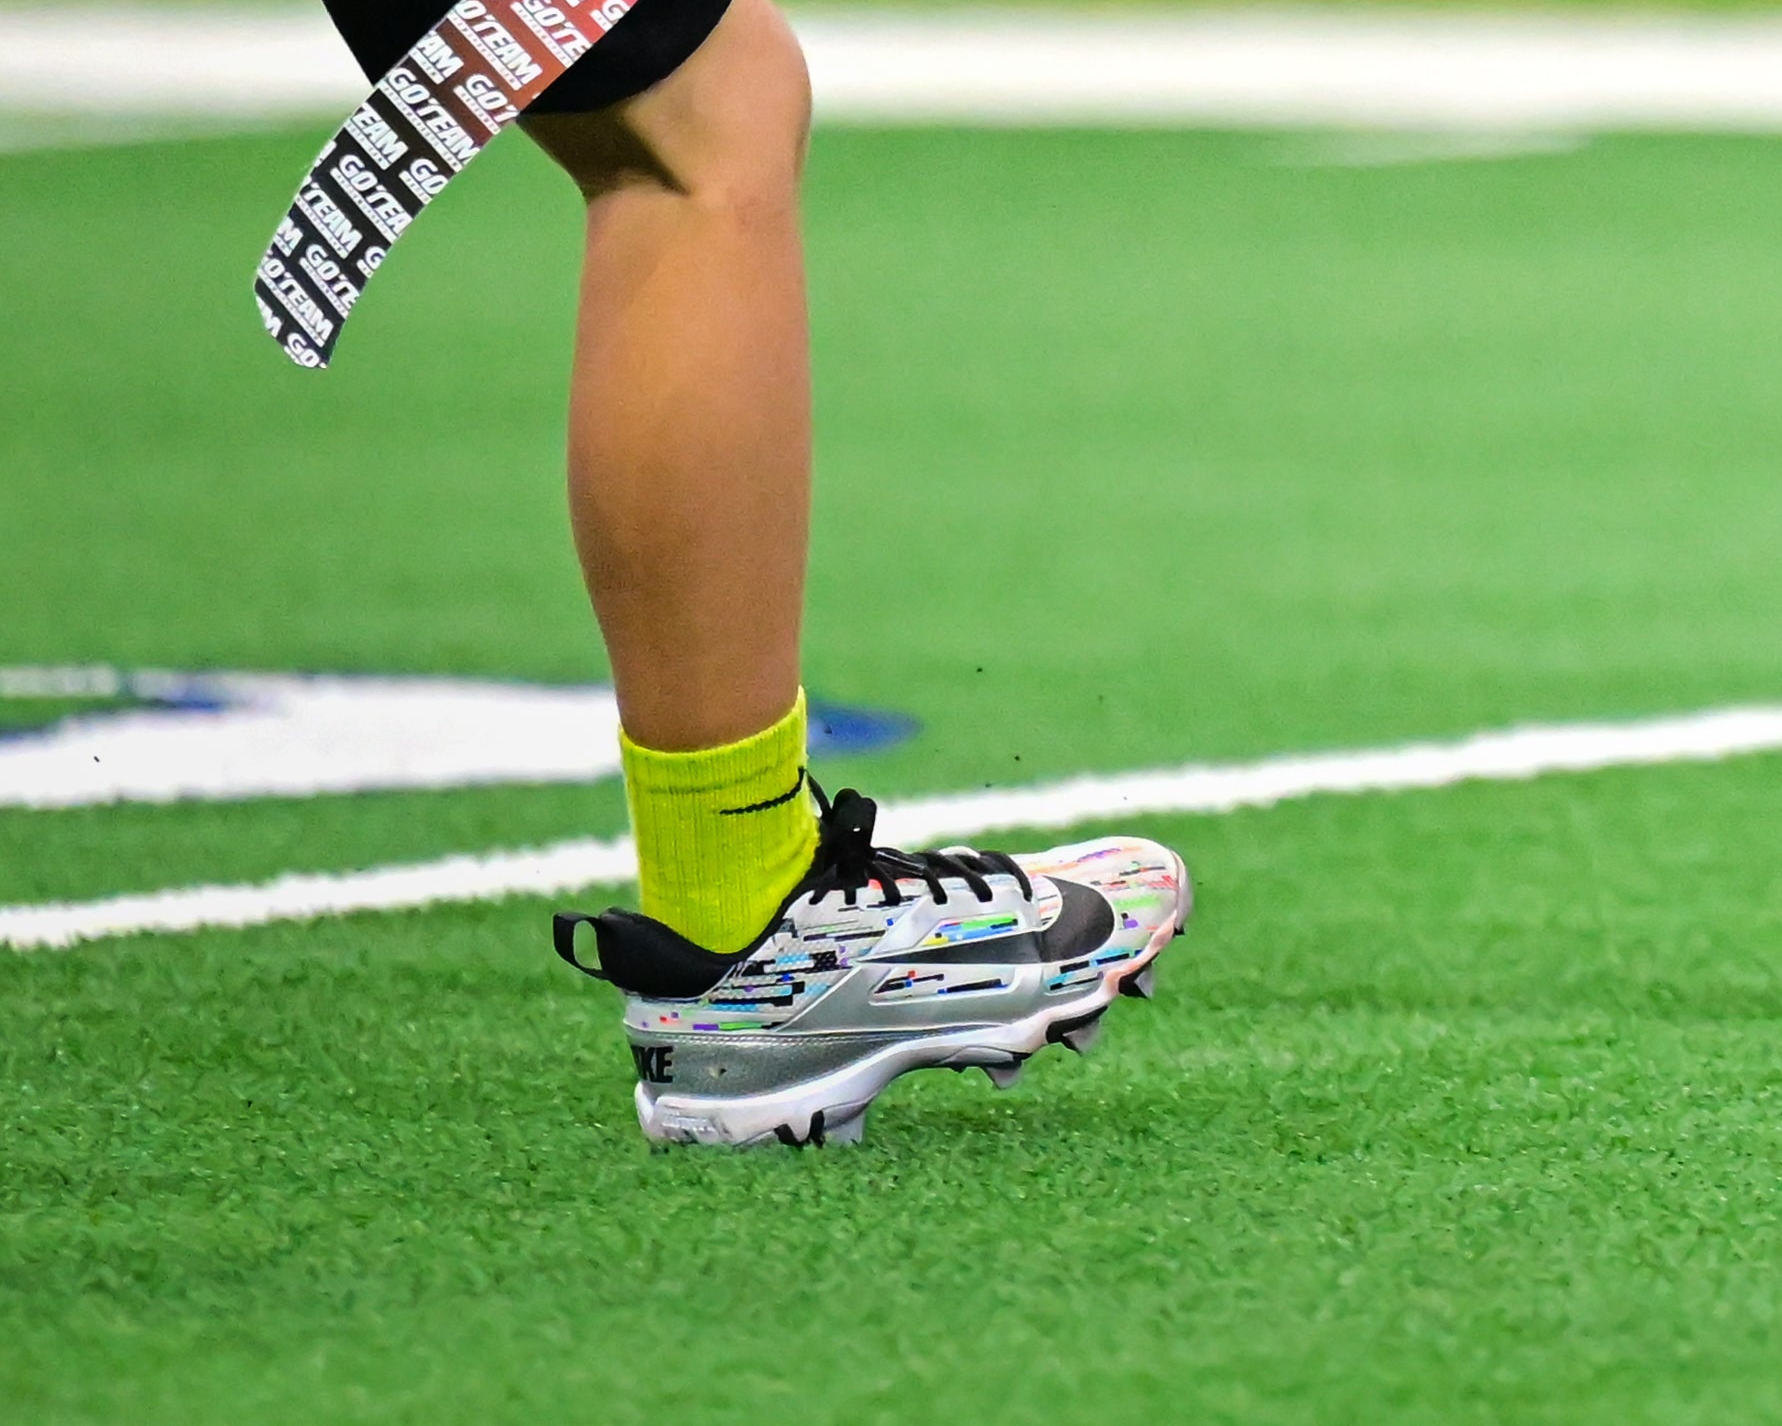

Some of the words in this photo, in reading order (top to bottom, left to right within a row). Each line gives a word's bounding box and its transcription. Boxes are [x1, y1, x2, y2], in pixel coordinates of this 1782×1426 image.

[300, 176, 364, 253] TEAM
[338, 153, 414, 238] GOTEA
[305, 243, 360, 310] GOTE
